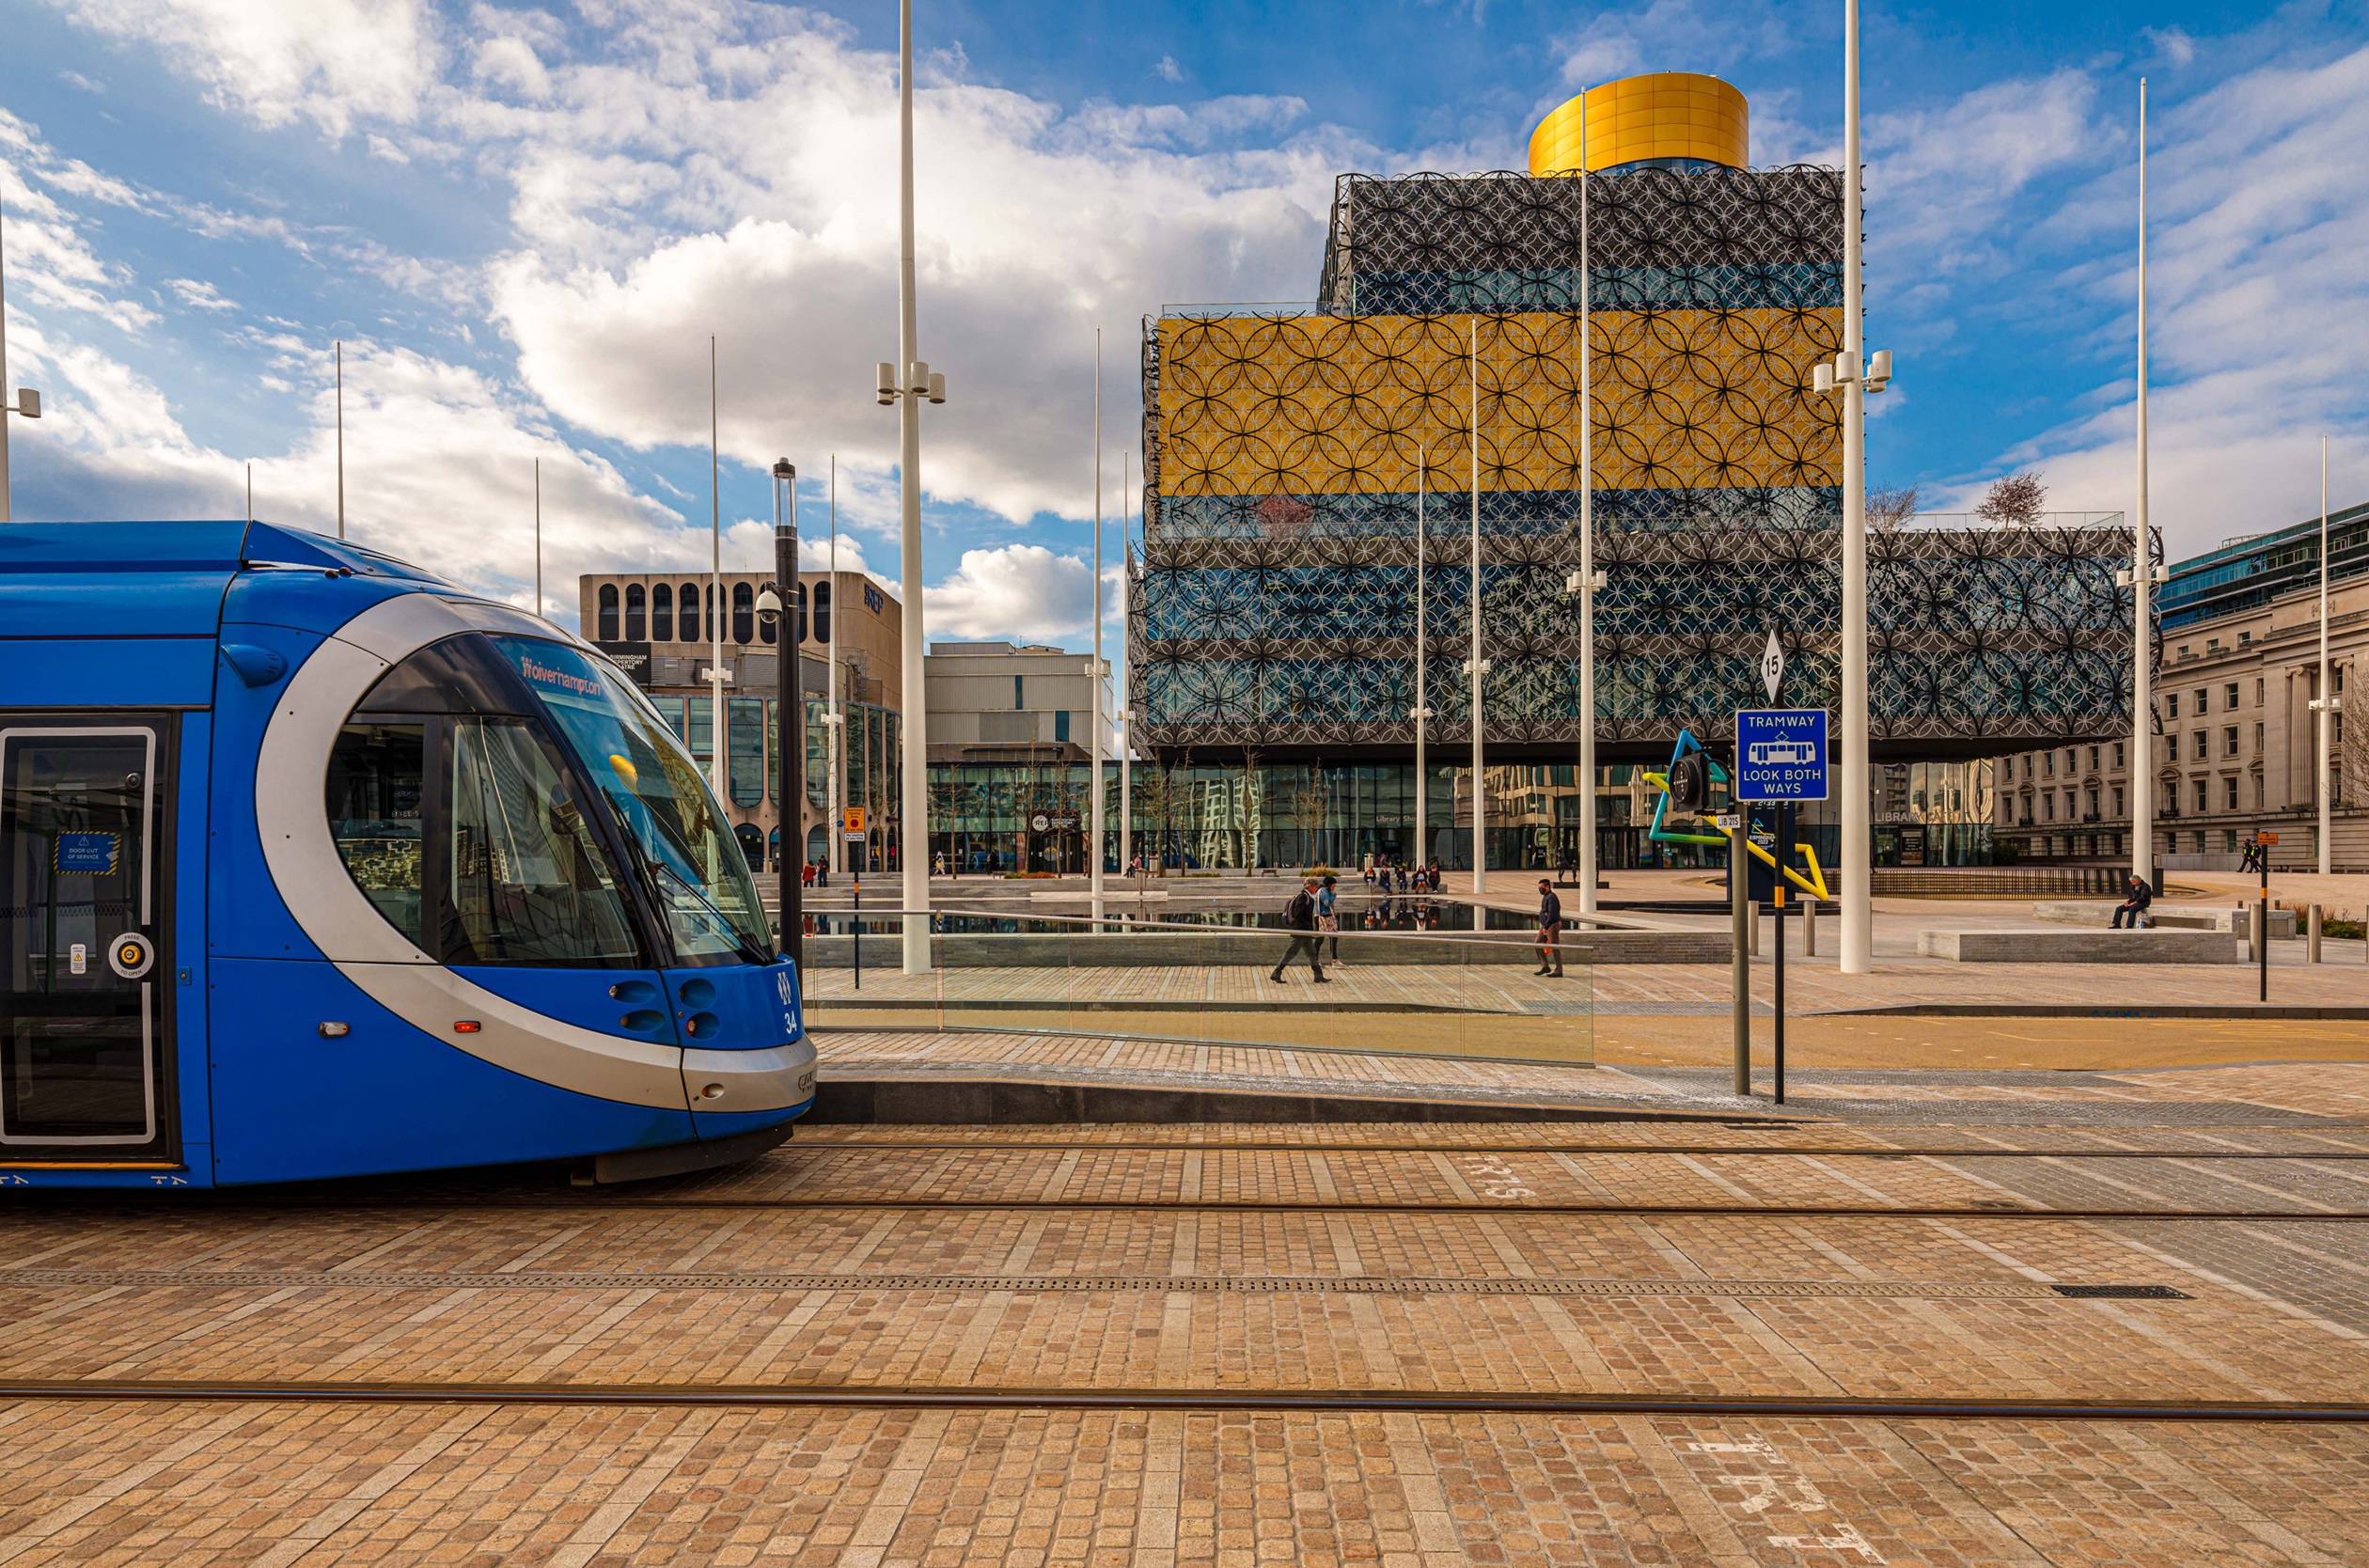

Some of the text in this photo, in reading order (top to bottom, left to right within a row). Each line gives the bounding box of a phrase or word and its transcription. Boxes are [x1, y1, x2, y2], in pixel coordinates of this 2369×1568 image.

[1765, 655, 1779, 677] 15
[1749, 716, 1815, 727] TRAMWAY
[1744, 769, 1821, 781] LOOK BOTH
[1764, 783, 1801, 793] WAYS
[1376, 815, 1401, 823] Library
[1718, 817, 1728, 826] LIB
[784, 1011, 798, 1035] 34
